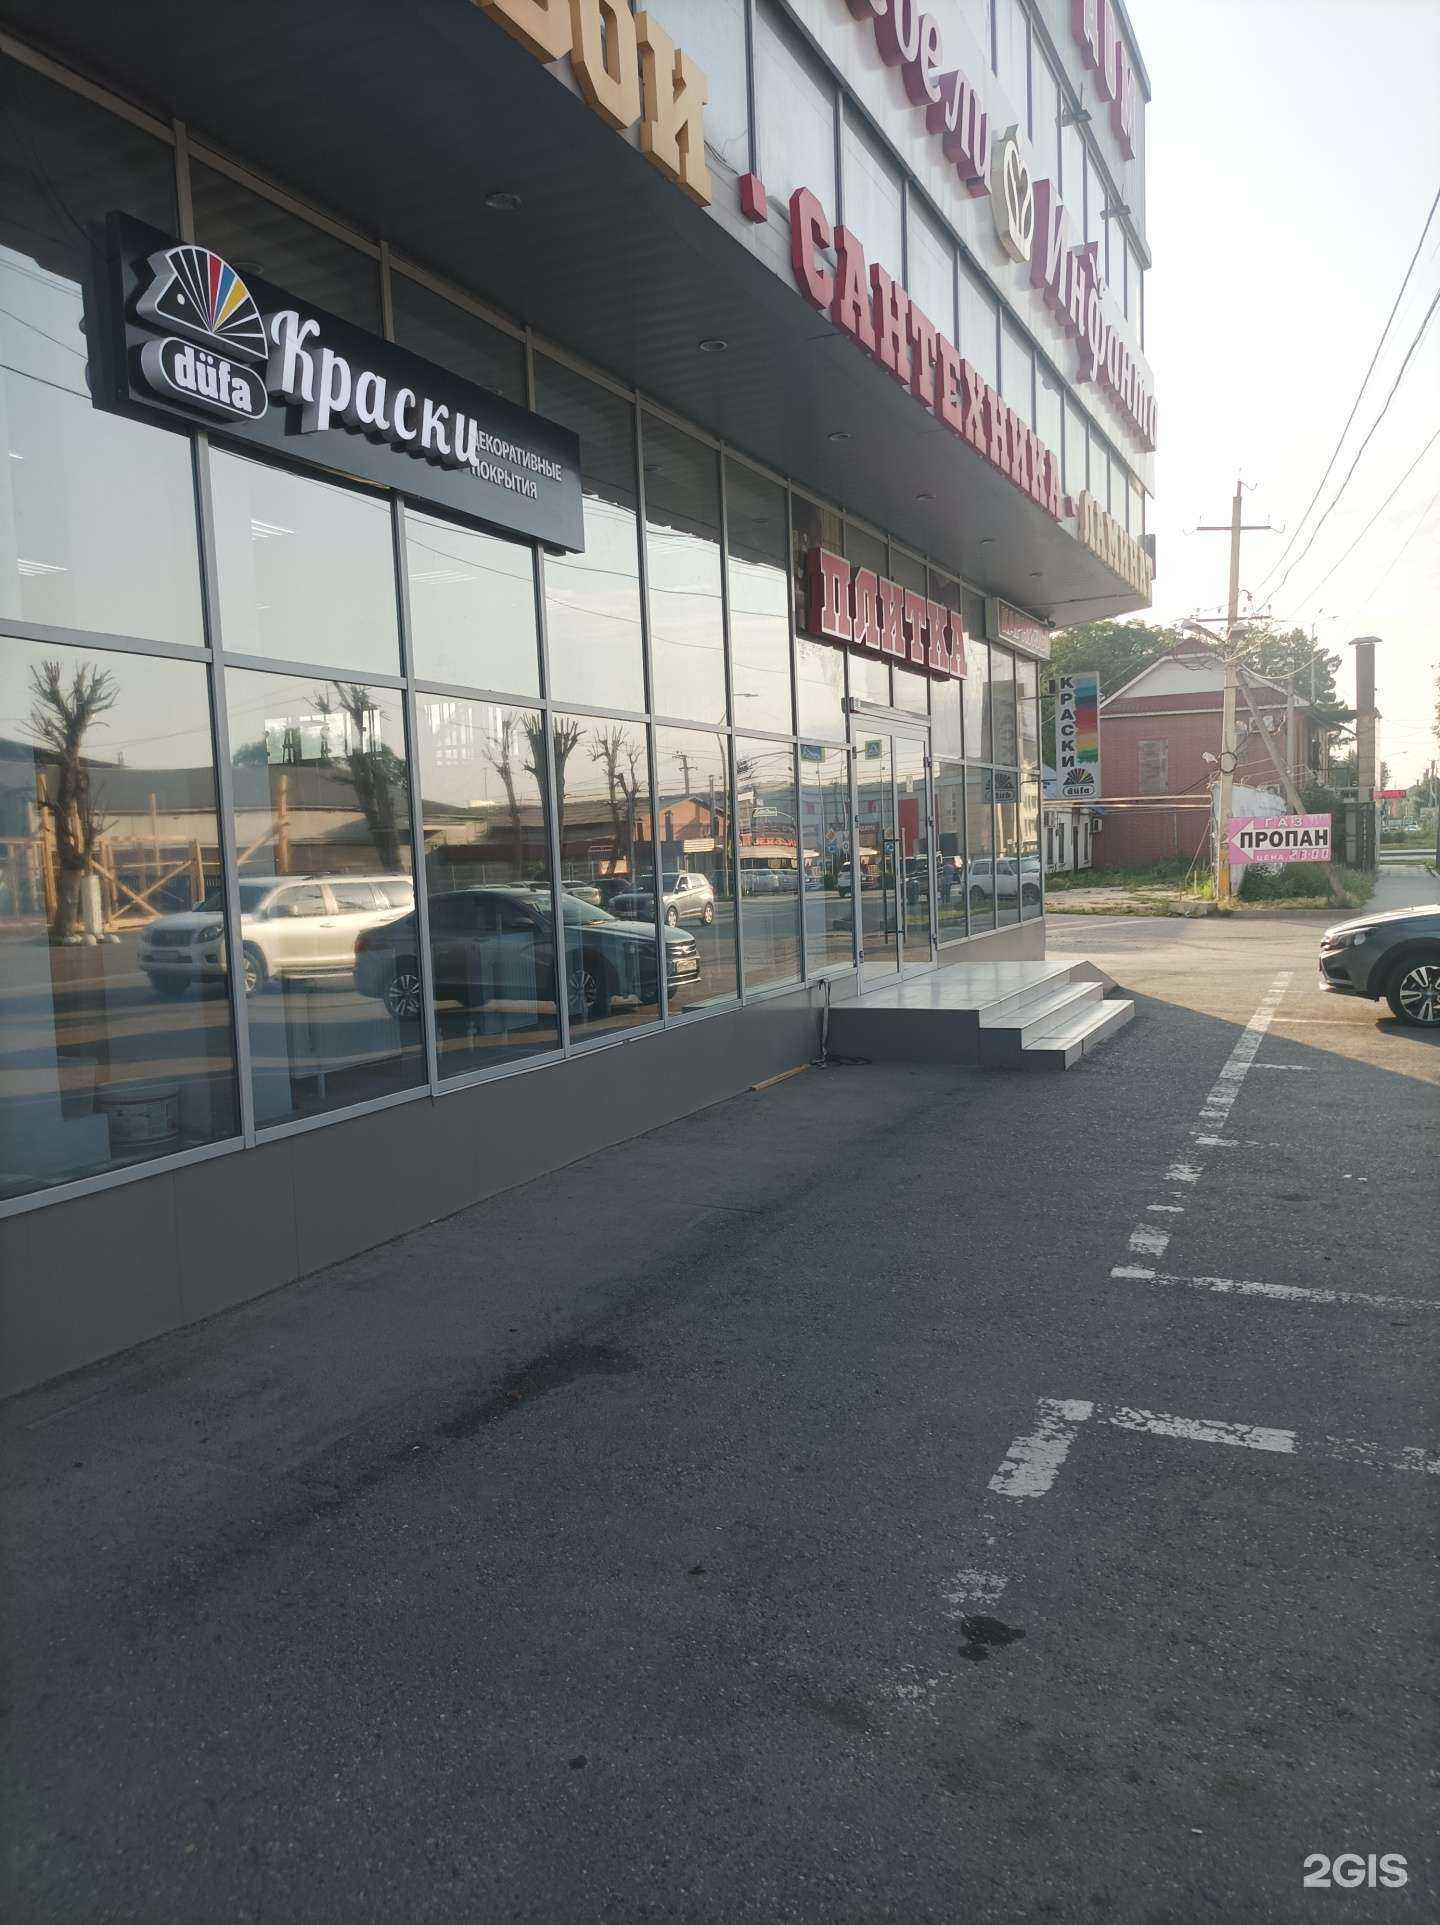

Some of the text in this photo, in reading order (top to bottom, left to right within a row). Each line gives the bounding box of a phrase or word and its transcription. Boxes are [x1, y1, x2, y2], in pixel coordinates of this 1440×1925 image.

[174, 346, 252, 413] düfa
[270, 309, 480, 467] Краски
[789, 186, 1063, 522] САНТЕХНИКА
[475, 430, 562, 481] ЕКОРАТИВНЫЕ
[815, 547, 968, 681] ПЛИТКА
[1060, 676, 1075, 768] КРАСКИ
[1240, 829, 1328, 848] ПРОПАН
